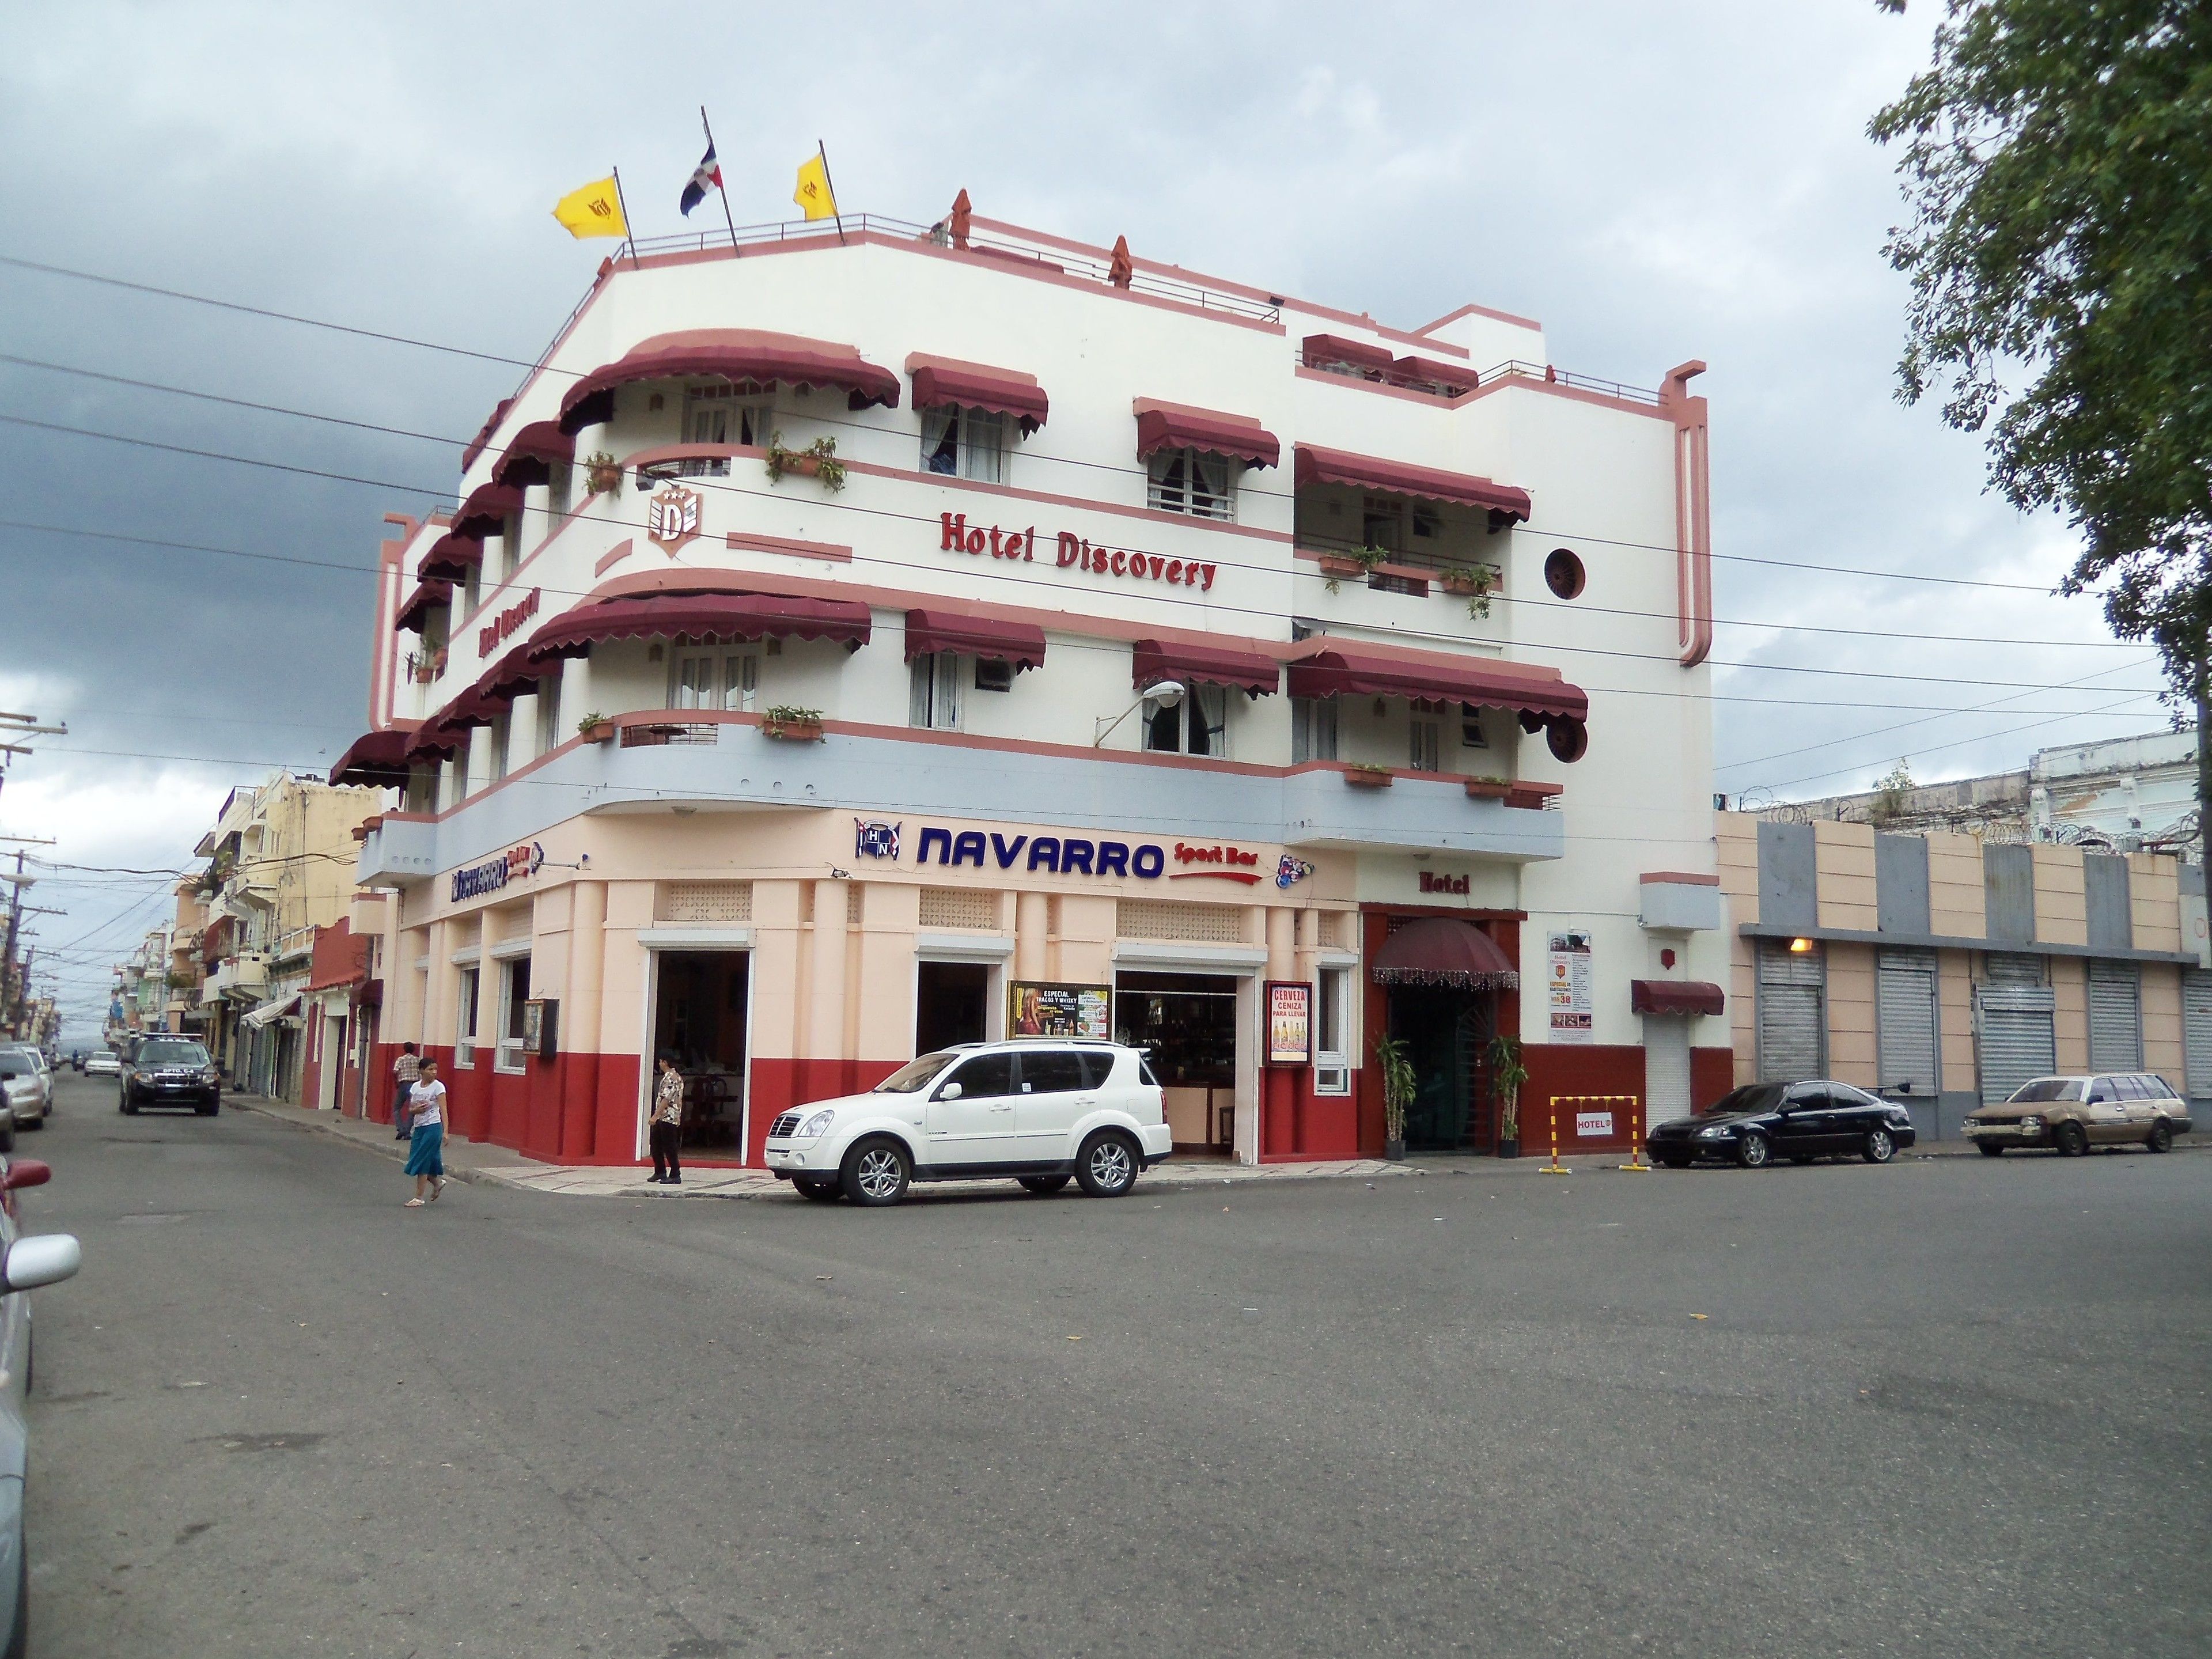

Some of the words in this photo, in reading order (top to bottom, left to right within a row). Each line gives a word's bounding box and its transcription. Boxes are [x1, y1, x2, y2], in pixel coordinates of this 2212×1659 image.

[940, 512, 1035, 562] Hotel
[1055, 531, 1217, 592] Discovery
[917, 827, 1165, 879] NAVARRO
[1173, 842, 1223, 865] Sport
[1226, 847, 1258, 866] Bar
[1419, 871, 1470, 895] Hotel
[1274, 990, 1305, 1001] CERVEZA
[1578, 1120, 1605, 1128] HOTEL
